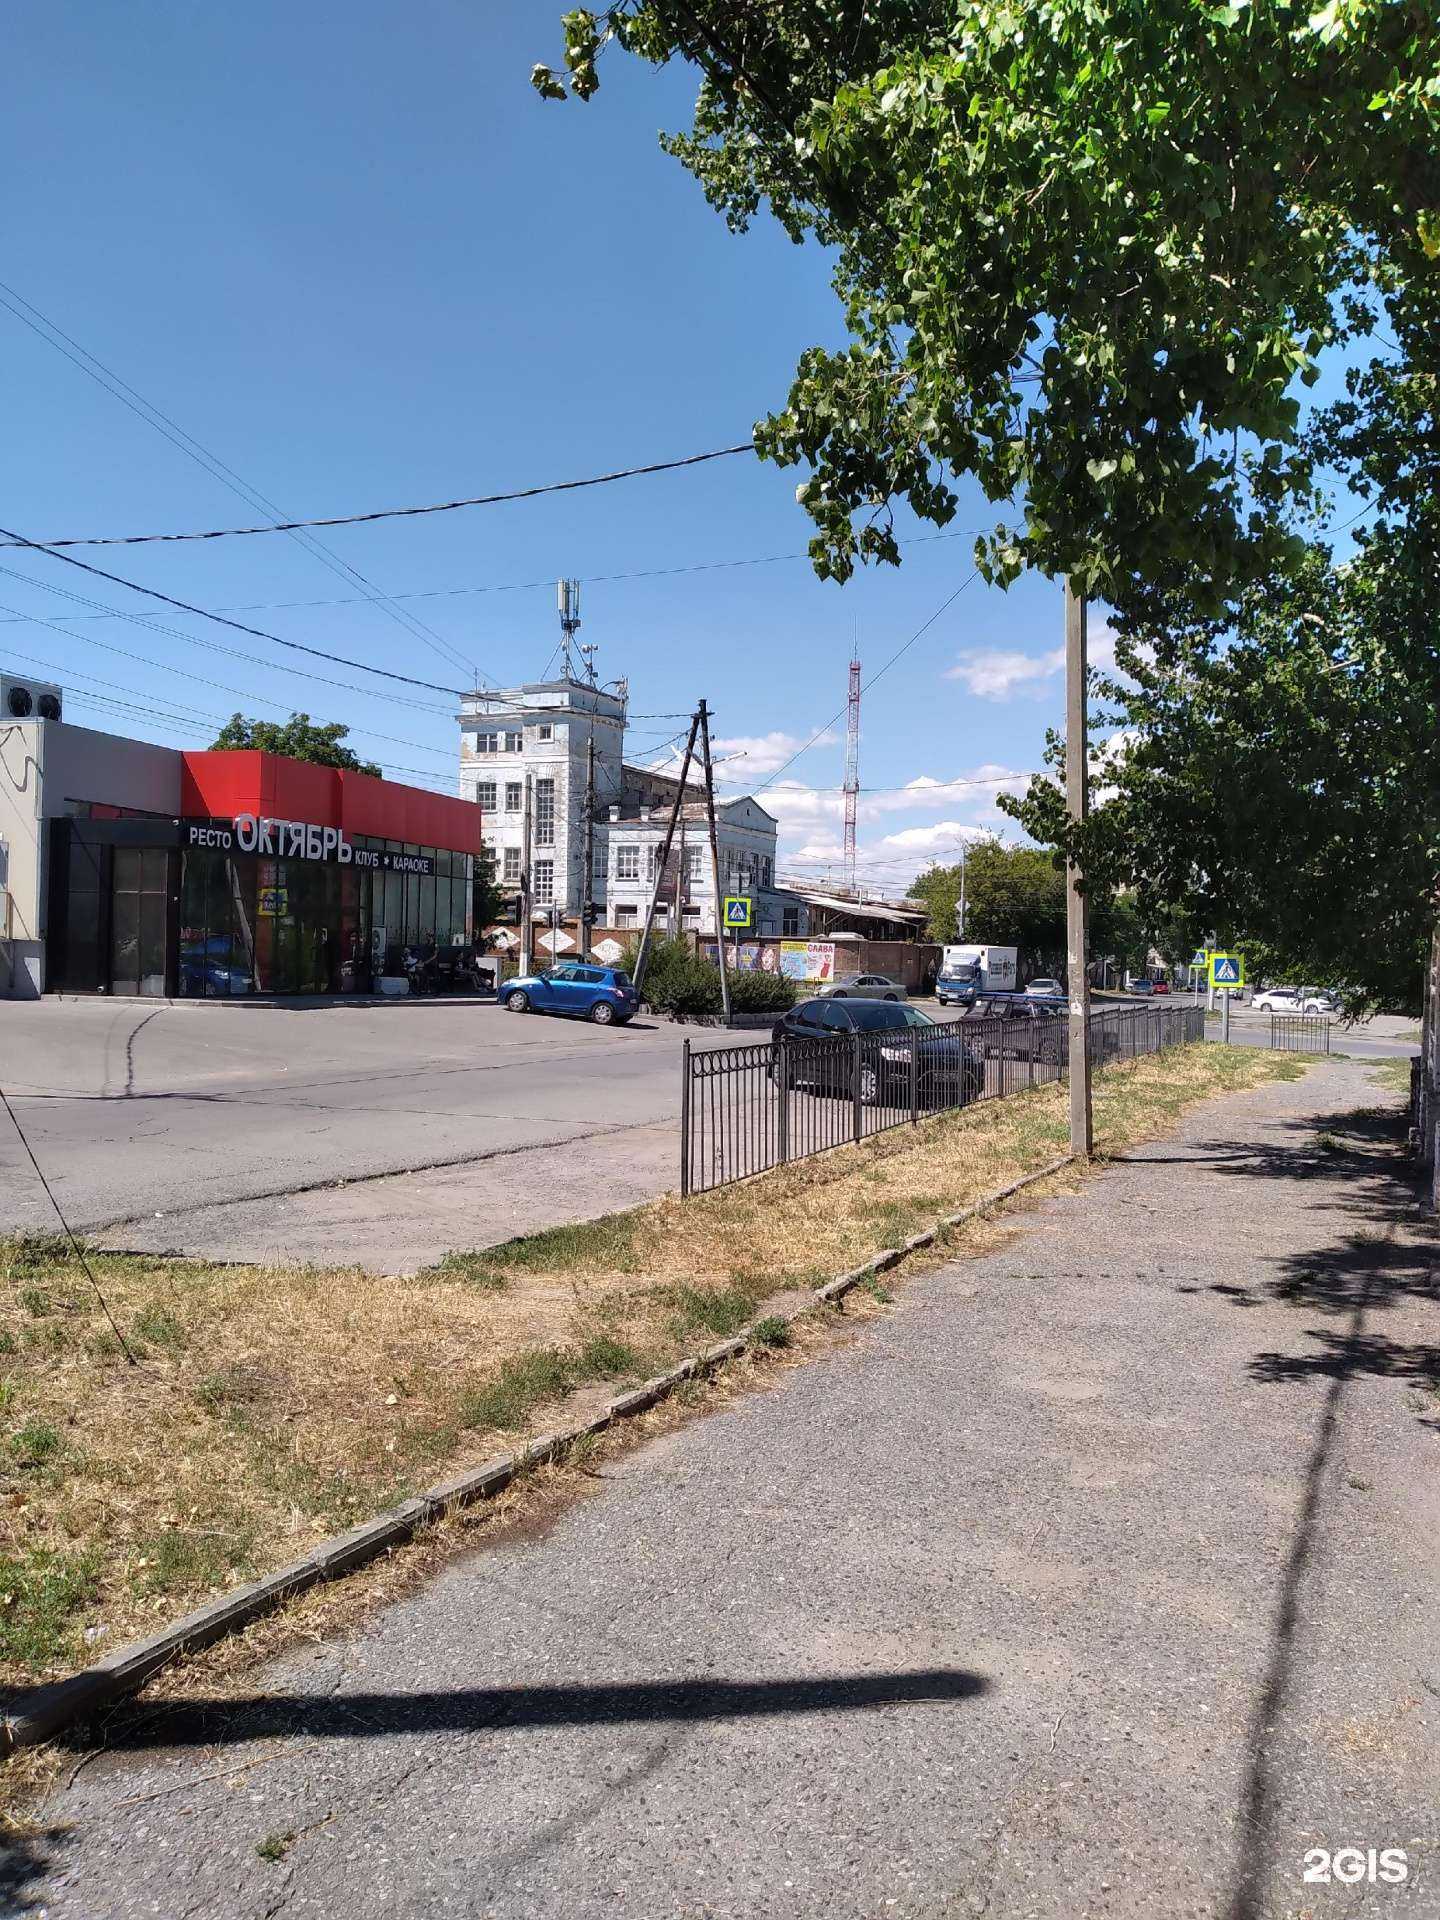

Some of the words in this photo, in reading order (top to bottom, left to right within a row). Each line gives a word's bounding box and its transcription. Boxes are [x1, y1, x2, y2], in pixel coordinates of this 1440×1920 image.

[189, 827, 232, 849] РЕСТО
[237, 813, 352, 863] ОКТЯБРЬ
[355, 850, 379, 867] КЛУБ
[393, 855, 429, 874] КАРАОКЕ
